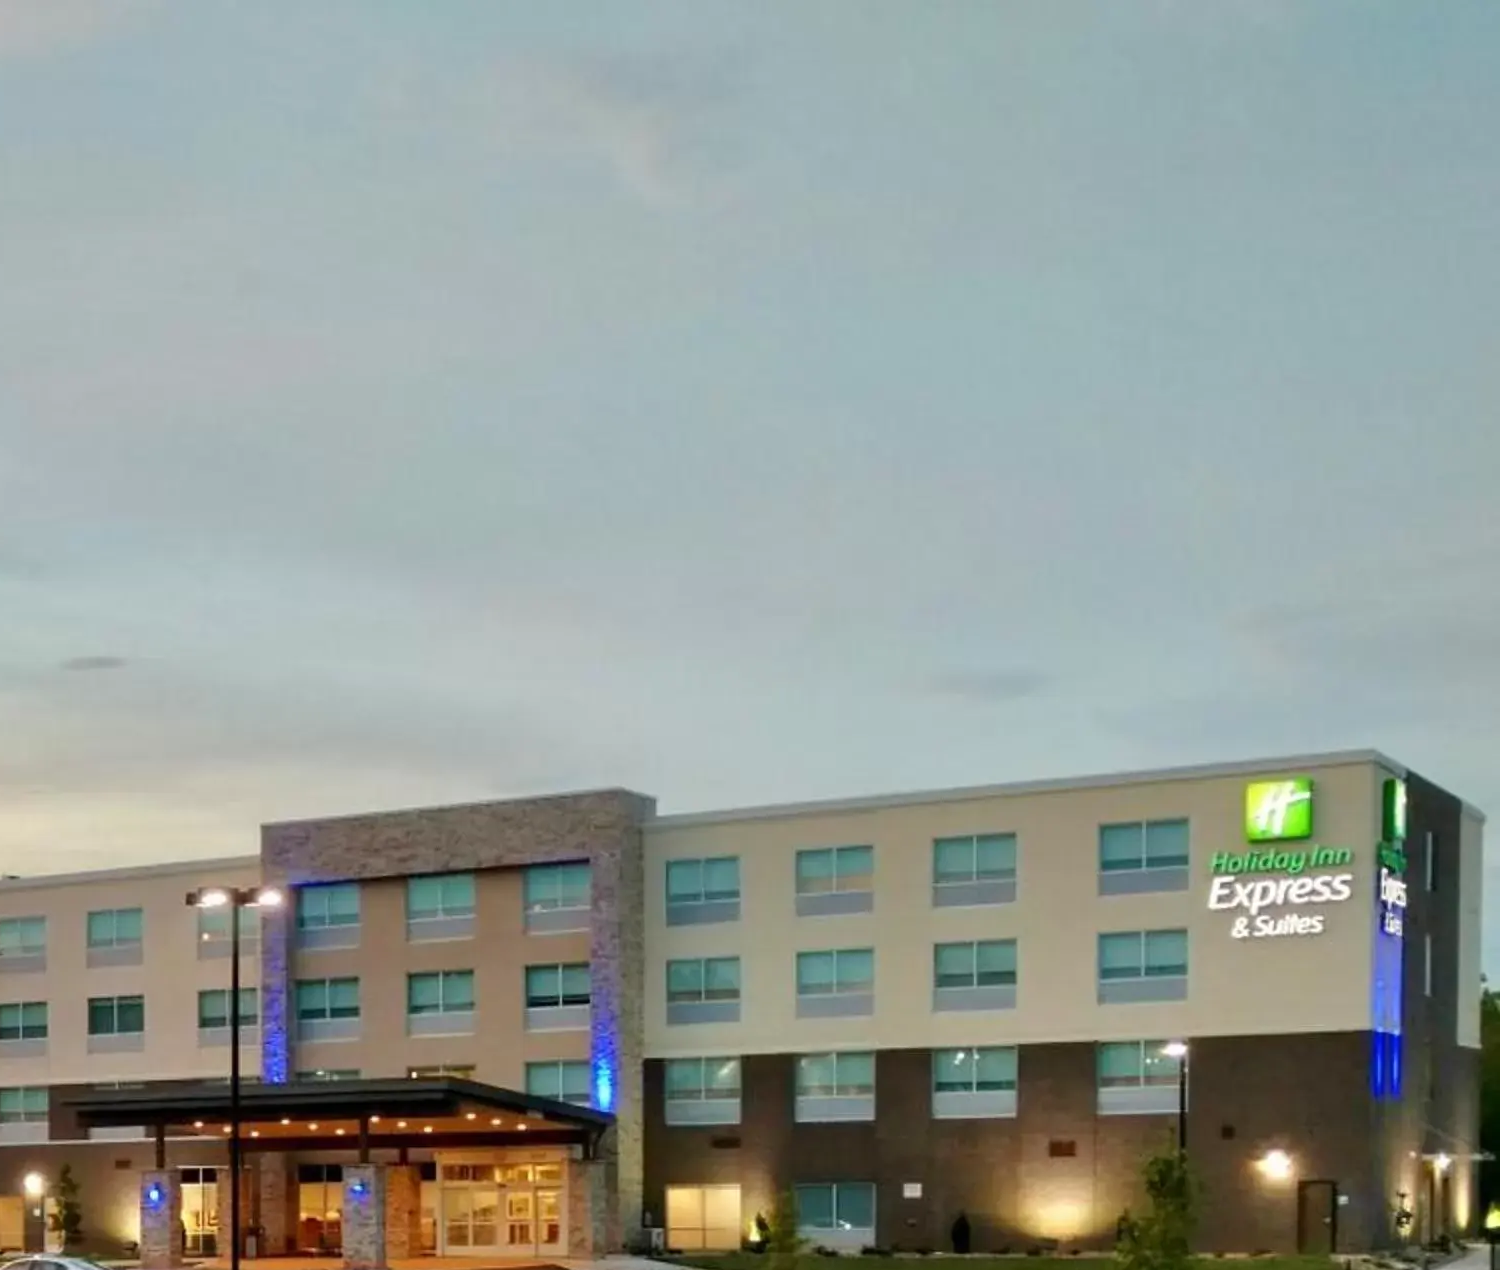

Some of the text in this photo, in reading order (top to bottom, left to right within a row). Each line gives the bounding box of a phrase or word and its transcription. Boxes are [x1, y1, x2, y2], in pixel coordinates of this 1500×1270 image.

[1208, 848, 1306, 874] Holiday
[1310, 844, 1351, 867] Inn
[1208, 873, 1353, 916] Express
[1230, 913, 1325, 938] & Suites
